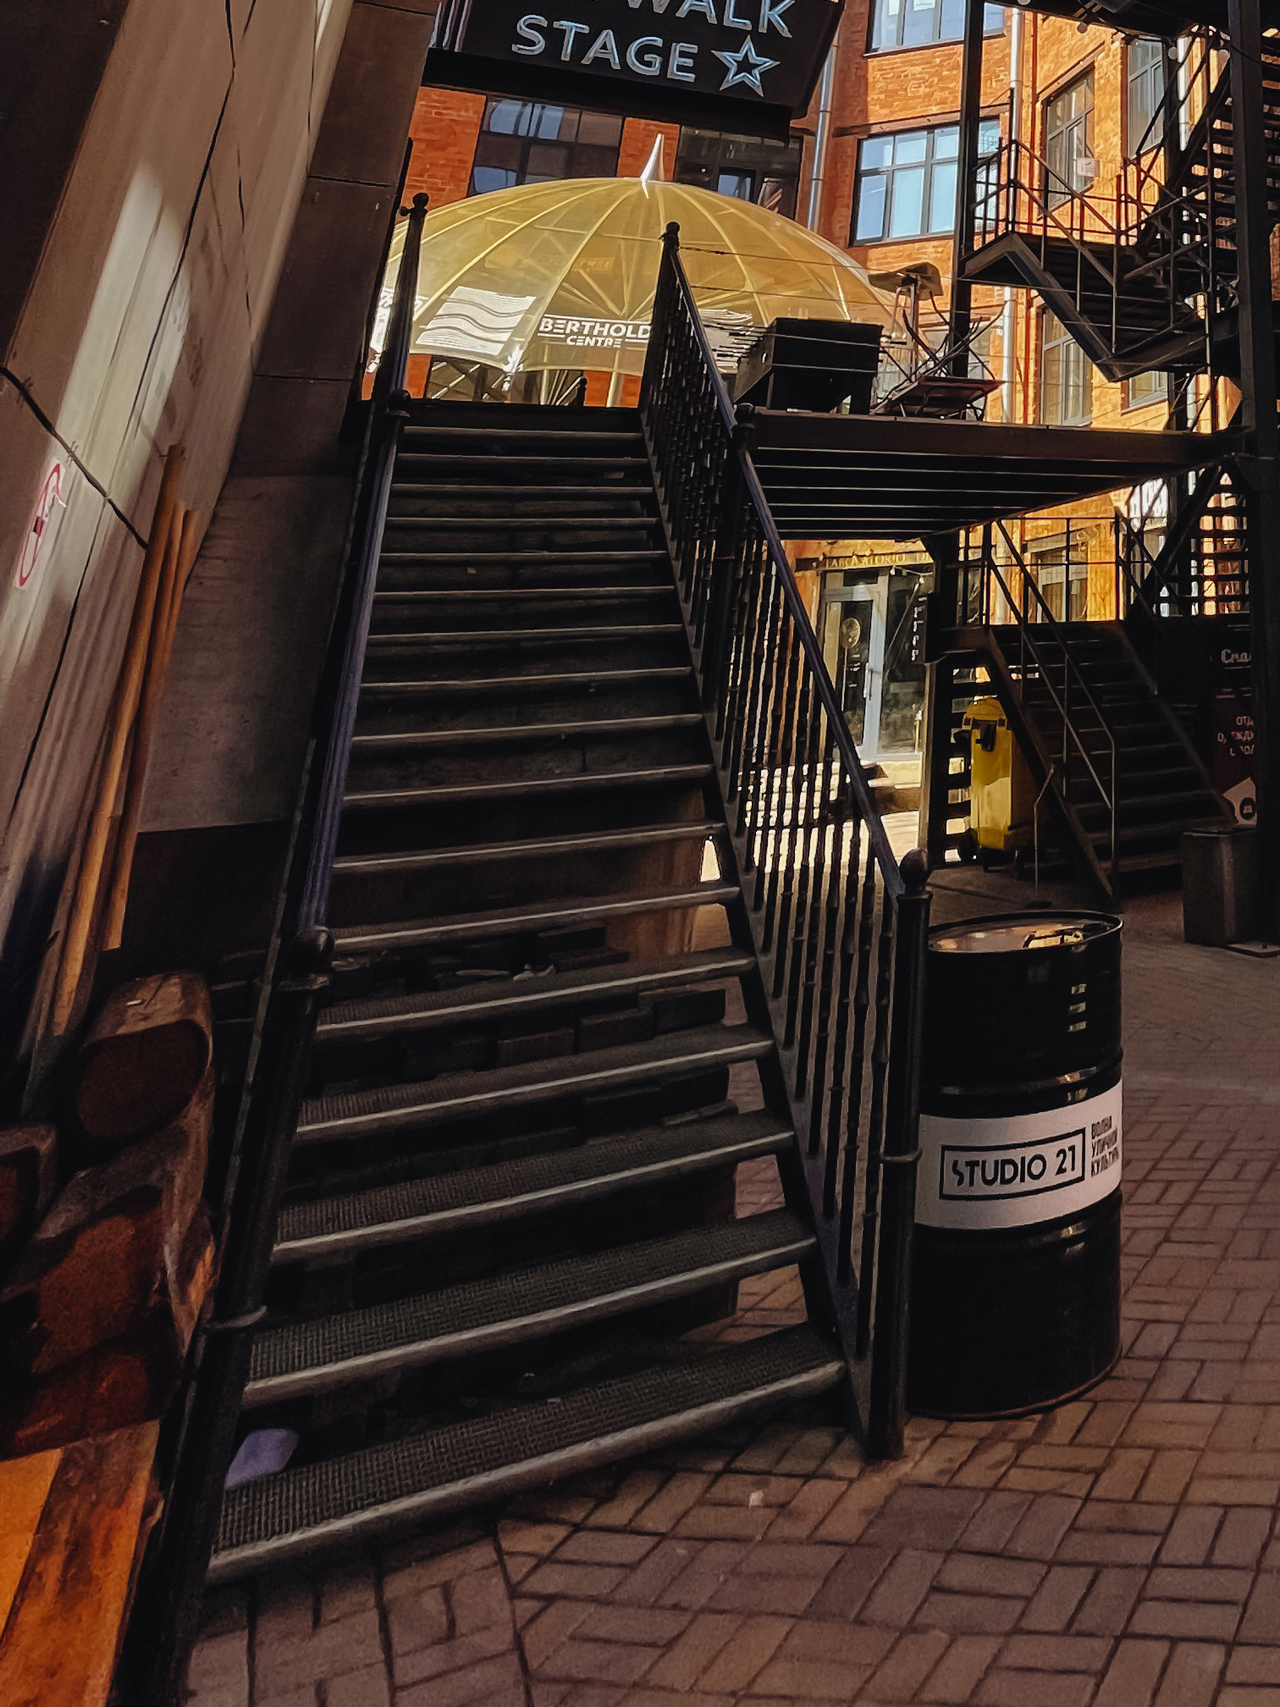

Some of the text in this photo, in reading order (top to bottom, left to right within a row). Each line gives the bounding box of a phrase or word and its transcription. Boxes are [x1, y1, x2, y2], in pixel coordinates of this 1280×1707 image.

[511, 14, 698, 82] STAGE
[539, 317, 651, 339] BERTHOLD
[566, 335, 623, 348] CENTRE
[952, 1144, 1076, 1187] STUDIO 21
